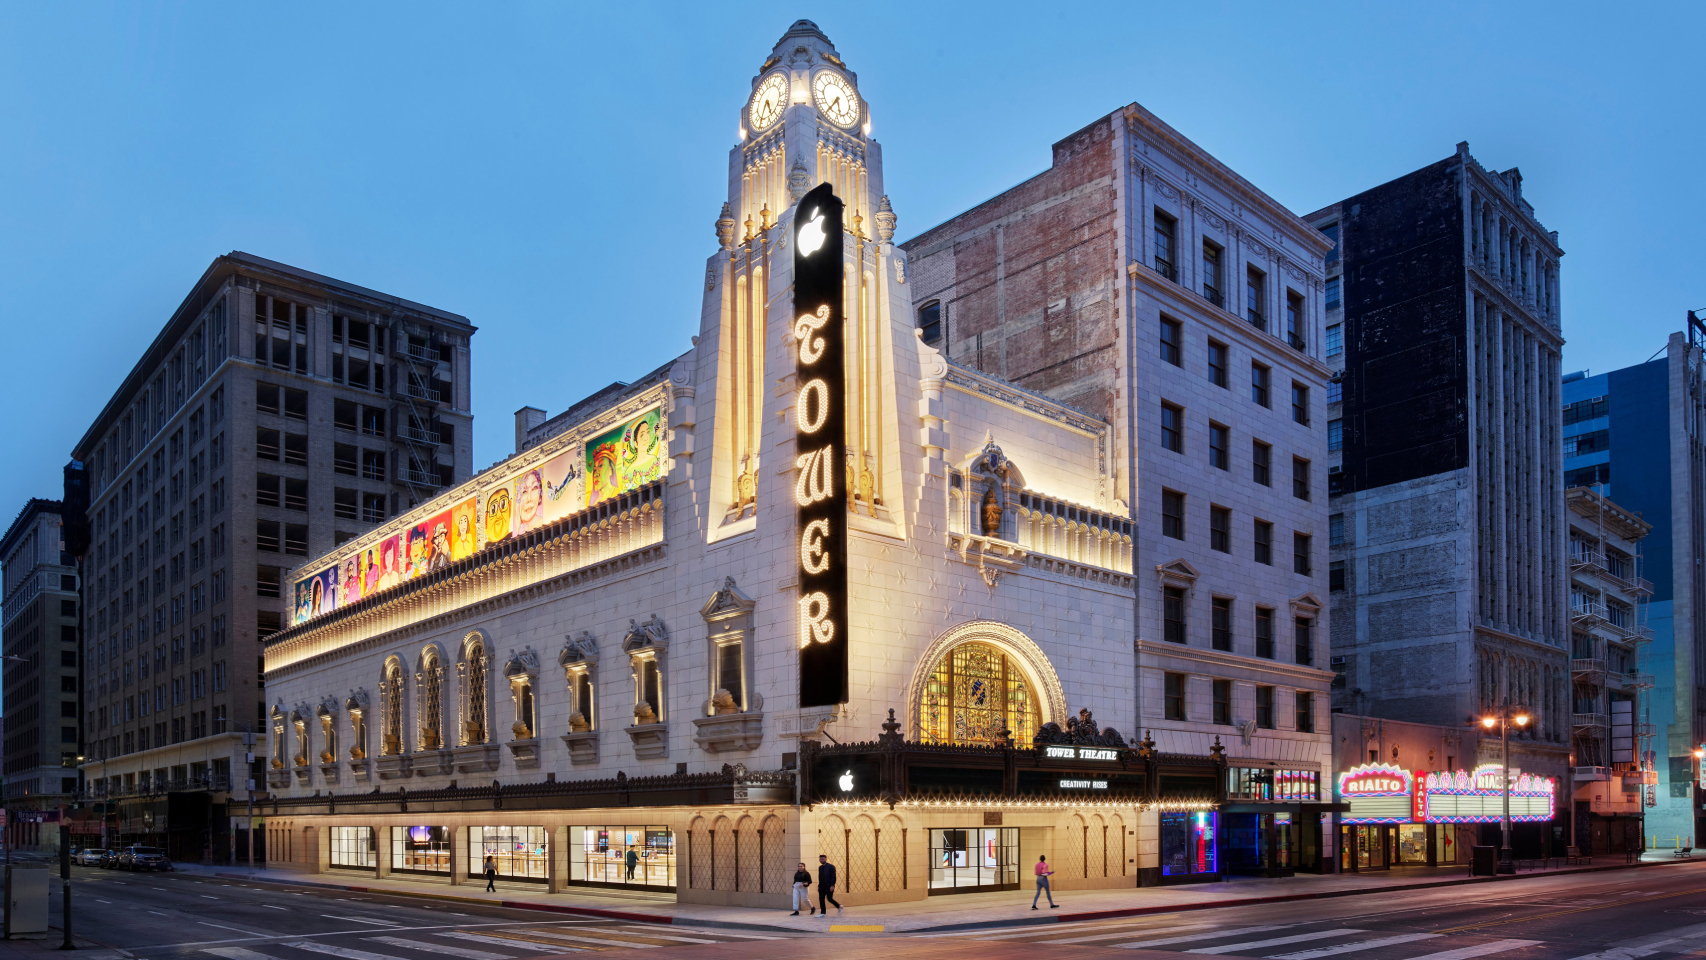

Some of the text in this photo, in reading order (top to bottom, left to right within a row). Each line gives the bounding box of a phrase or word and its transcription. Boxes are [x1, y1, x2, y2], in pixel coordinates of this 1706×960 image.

[795, 304, 834, 648] TOWER
[1046, 747, 1117, 760] TOWER THEATRE
[1060, 780, 1108, 789] CREATIVITY RISES
[1348, 779, 1400, 791] RIALTO
[18, 811, 48, 819] Broadway
